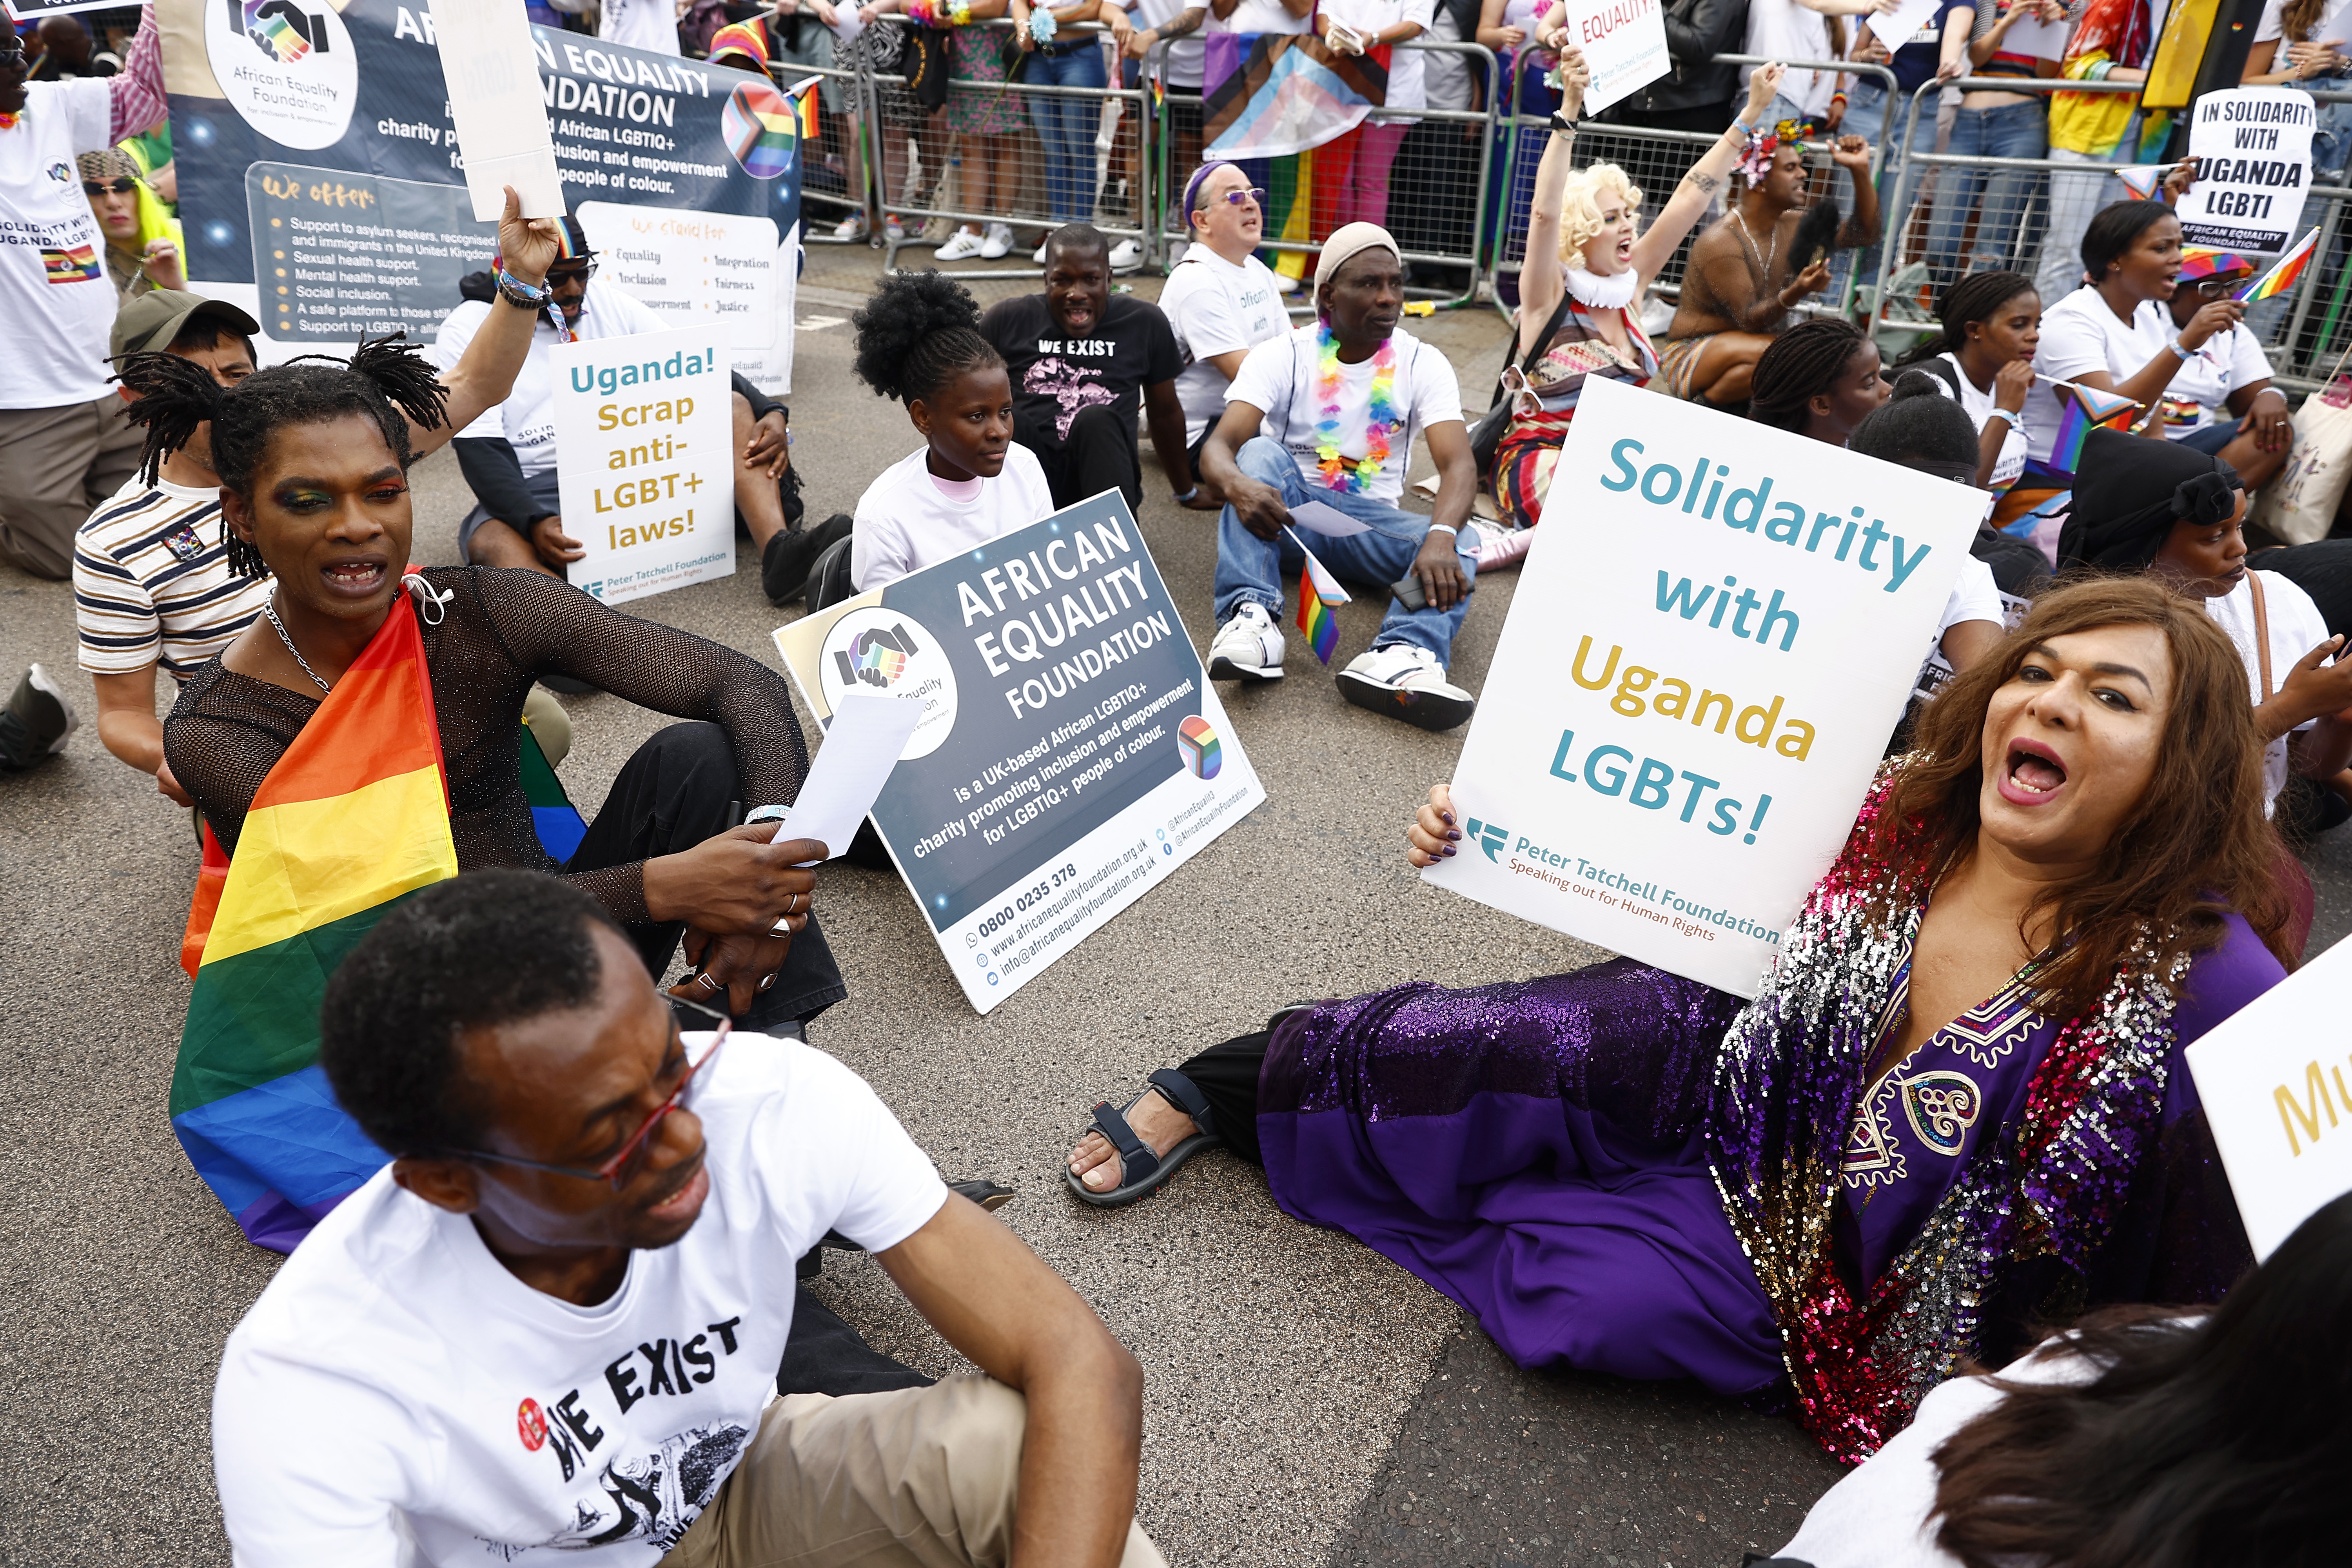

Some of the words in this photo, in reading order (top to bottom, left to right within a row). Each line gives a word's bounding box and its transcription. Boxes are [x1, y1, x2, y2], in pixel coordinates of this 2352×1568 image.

[234, 65, 283, 86] African
[286, 76, 338, 101] Equality
[563, 43, 709, 98] EQUALITY
[252, 87, 328, 112] Foundation
[538, 74, 676, 127] NDATION
[2202, 102, 2220, 123] IN
[2224, 101, 2313, 127] SOLIDARITY
[377, 118, 440, 146] charity
[603, 151, 629, 167] and
[632, 155, 728, 179] empowerment
[558, 118, 610, 142] African
[613, 127, 676, 151] LGBTIQ+
[2234, 127, 2279, 150] WITH
[262, 174, 301, 200] We
[449, 151, 464, 169] fo
[559, 167, 608, 188] people
[610, 172, 626, 188] of
[628, 176, 675, 194] colour.
[2196, 158, 2302, 188] UGANDA
[2205, 191, 2273, 219] LGBTI
[290, 216, 340, 234] Support
[341, 222, 354, 234] to
[356, 225, 394, 238] asylum
[441, 232, 496, 247] recognised
[292, 235, 317, 247] and
[319, 235, 384, 253] immigrants
[384, 241, 394, 253] in
[396, 242, 414, 254] the
[415, 244, 448, 258] United
[2181, 224, 2228, 237] AFRICAN
[2227, 228, 2283, 243] EQUALITY
[2190, 235, 2262, 250] FOUNDATION
[293, 250, 336, 265] Sexual
[338, 254, 374, 268] health
[376, 258, 420, 272] support.
[295, 267, 337, 282] Mental
[339, 270, 376, 285] health
[377, 274, 422, 287] support.
[616, 248, 661, 265] Equality
[715, 255, 769, 271] Integration
[296, 285, 335, 299] Social
[337, 287, 393, 301] inclusion.
[506, 277, 526, 291] PARADE
[619, 272, 667, 286] Inclusion
[715, 278, 755, 290] Fairness
[297, 302, 307, 314] A
[309, 302, 337, 316] safe
[339, 304, 387, 318] platform
[389, 306, 398, 318] to
[400, 306, 432, 319] those
[433, 307, 452, 319] still
[715, 299, 750, 314] Justice
[299, 318, 349, 335] Support
[350, 320, 364, 332] to
[366, 321, 417, 334] LGBTIQ+
[1038, 339, 1062, 354] WE
[1067, 339, 1116, 357] EXIST
[571, 347, 714, 396] Uganda!
[598, 397, 694, 431] Scrap
[609, 435, 687, 470] anti-
[594, 472, 704, 514] LGBT+
[609, 510, 695, 550] laws!
[1600, 437, 1932, 593] Solidarity
[608, 575, 633, 587] Peter
[636, 564, 673, 581] Tatchell
[675, 552, 726, 570] Foundation
[608, 584, 637, 597] Speaking
[661, 573, 683, 583] Human
[683, 568, 702, 579] Rights
[957, 515, 1131, 628] AFRICAN
[974, 559, 1149, 678] EQUALITY
[1655, 569, 1800, 652] with
[1005, 610, 1172, 720] FOUNDATION
[1571, 635, 1816, 762] Uganda
[916, 708, 950, 730] empowerment
[953, 787, 972, 804] is
[972, 779, 985, 794] a
[982, 737, 1051, 786] UK-based
[1050, 713, 1096, 748] African
[1094, 682, 1147, 721] LGBTIQ+
[913, 817, 967, 859] charity
[967, 774, 1042, 830] promoting
[1038, 739, 1098, 782] inclusion
[1097, 721, 1122, 747] and
[1121, 678, 1195, 732] empowerment
[983, 824, 1007, 846] for
[1005, 784, 1069, 832] LGBTIQ+
[1071, 757, 1114, 795] people
[1114, 744, 1129, 764] of
[1128, 724, 1167, 755] colour.
[1549, 728, 1773, 846] LGBTs!
[1167, 790, 1216, 832] @AfricanEqualit3
[1175, 787, 1249, 847] @AfricanEqualityFoundation
[978, 906, 1014, 938] 0800
[1016, 881, 1051, 912] 0235
[1051, 863, 1077, 888] 378
[991, 838, 1149, 958] www.africanequalityfoundation.org.uk
[1508, 858, 1571, 892] Speaking
[1572, 884, 1597, 899] out
[1598, 891, 1619, 906] for
[1620, 898, 1669, 925] Human
[1672, 917, 1716, 942] Rights
[1515, 836, 1572, 870] Peter
[1577, 858, 1658, 902] Tatchell
[1660, 889, 1780, 945] Foundation
[999, 855, 1157, 977] info@africanequalityfoundation.org.uk
[547, 1389, 604, 1483] WE
[605, 1316, 741, 1415] EXIST
